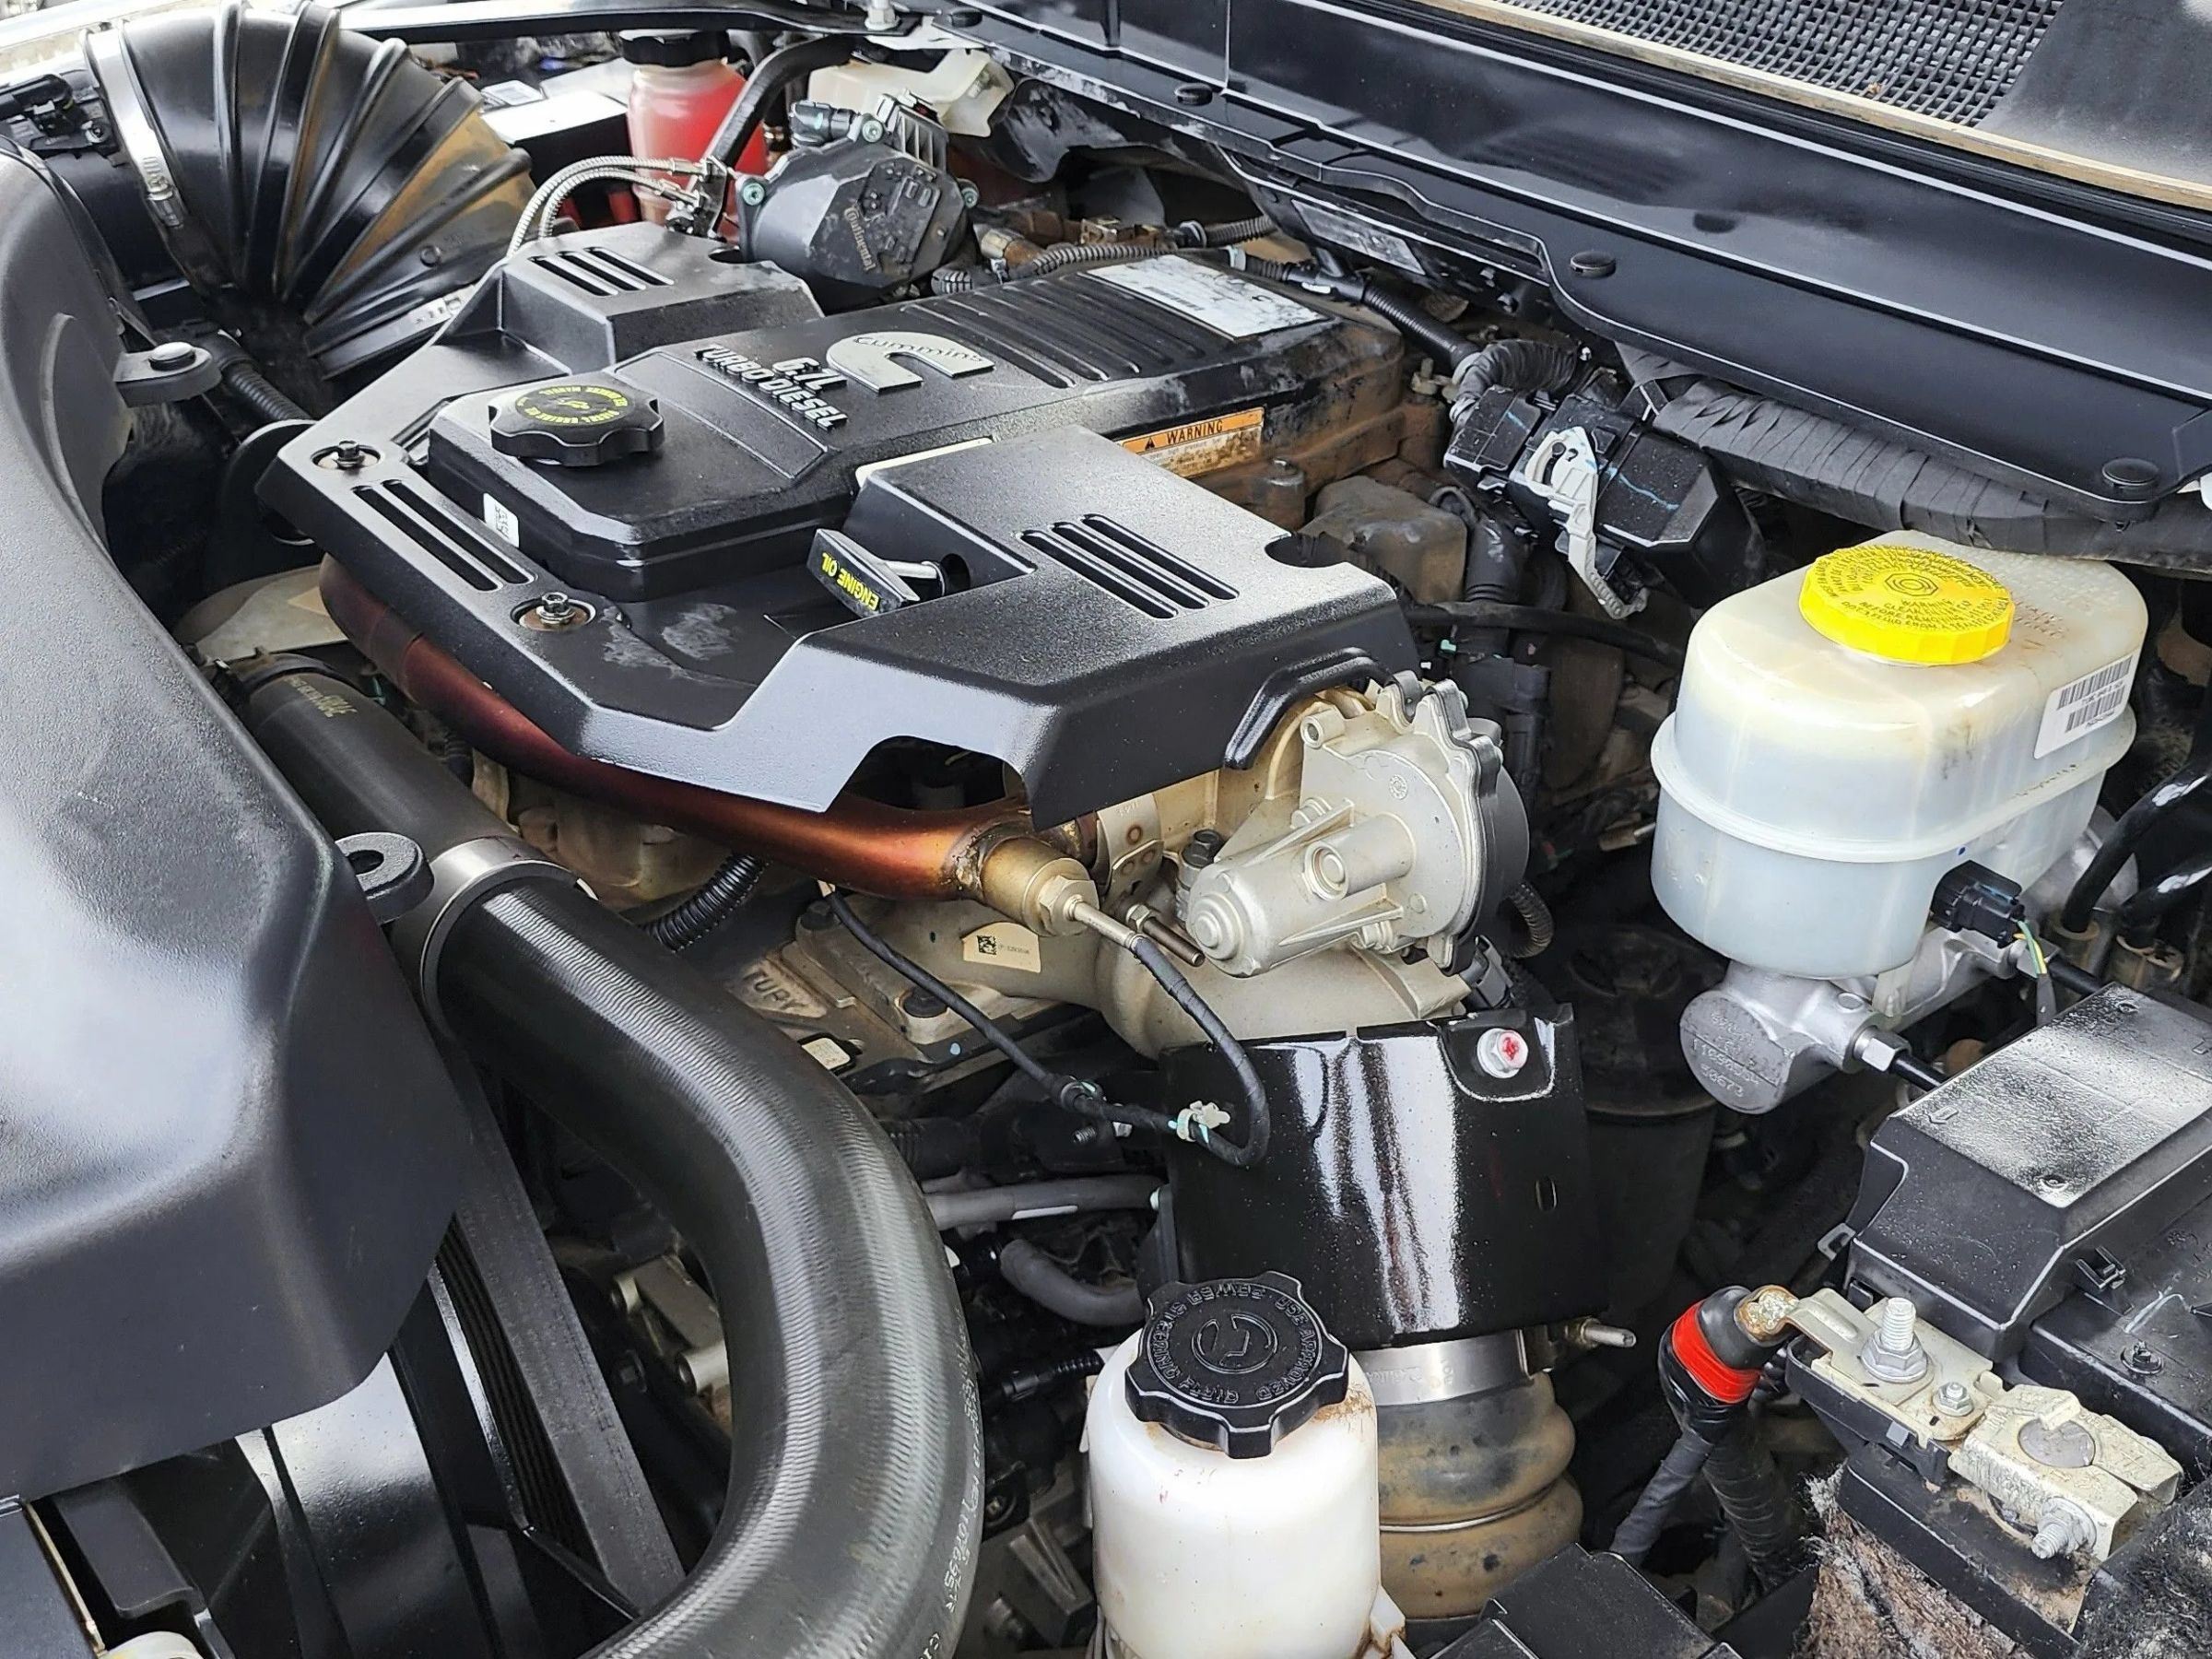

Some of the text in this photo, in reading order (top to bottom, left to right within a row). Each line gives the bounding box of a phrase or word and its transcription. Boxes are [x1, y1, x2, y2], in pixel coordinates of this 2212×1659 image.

[843, 204, 877, 272] Continental
[853, 336, 983, 362] Cummins
[693, 344, 849, 430] TURBO DIESEL
[772, 357, 848, 393] 6.7L
[1166, 418, 1223, 445] WARNING
[822, 552, 879, 611] ENGINE OIL
[1859, 602, 1903, 618] BEFORE
[1274, 1296, 1310, 1327] USE
[1150, 1300, 1188, 1380] STEERING
